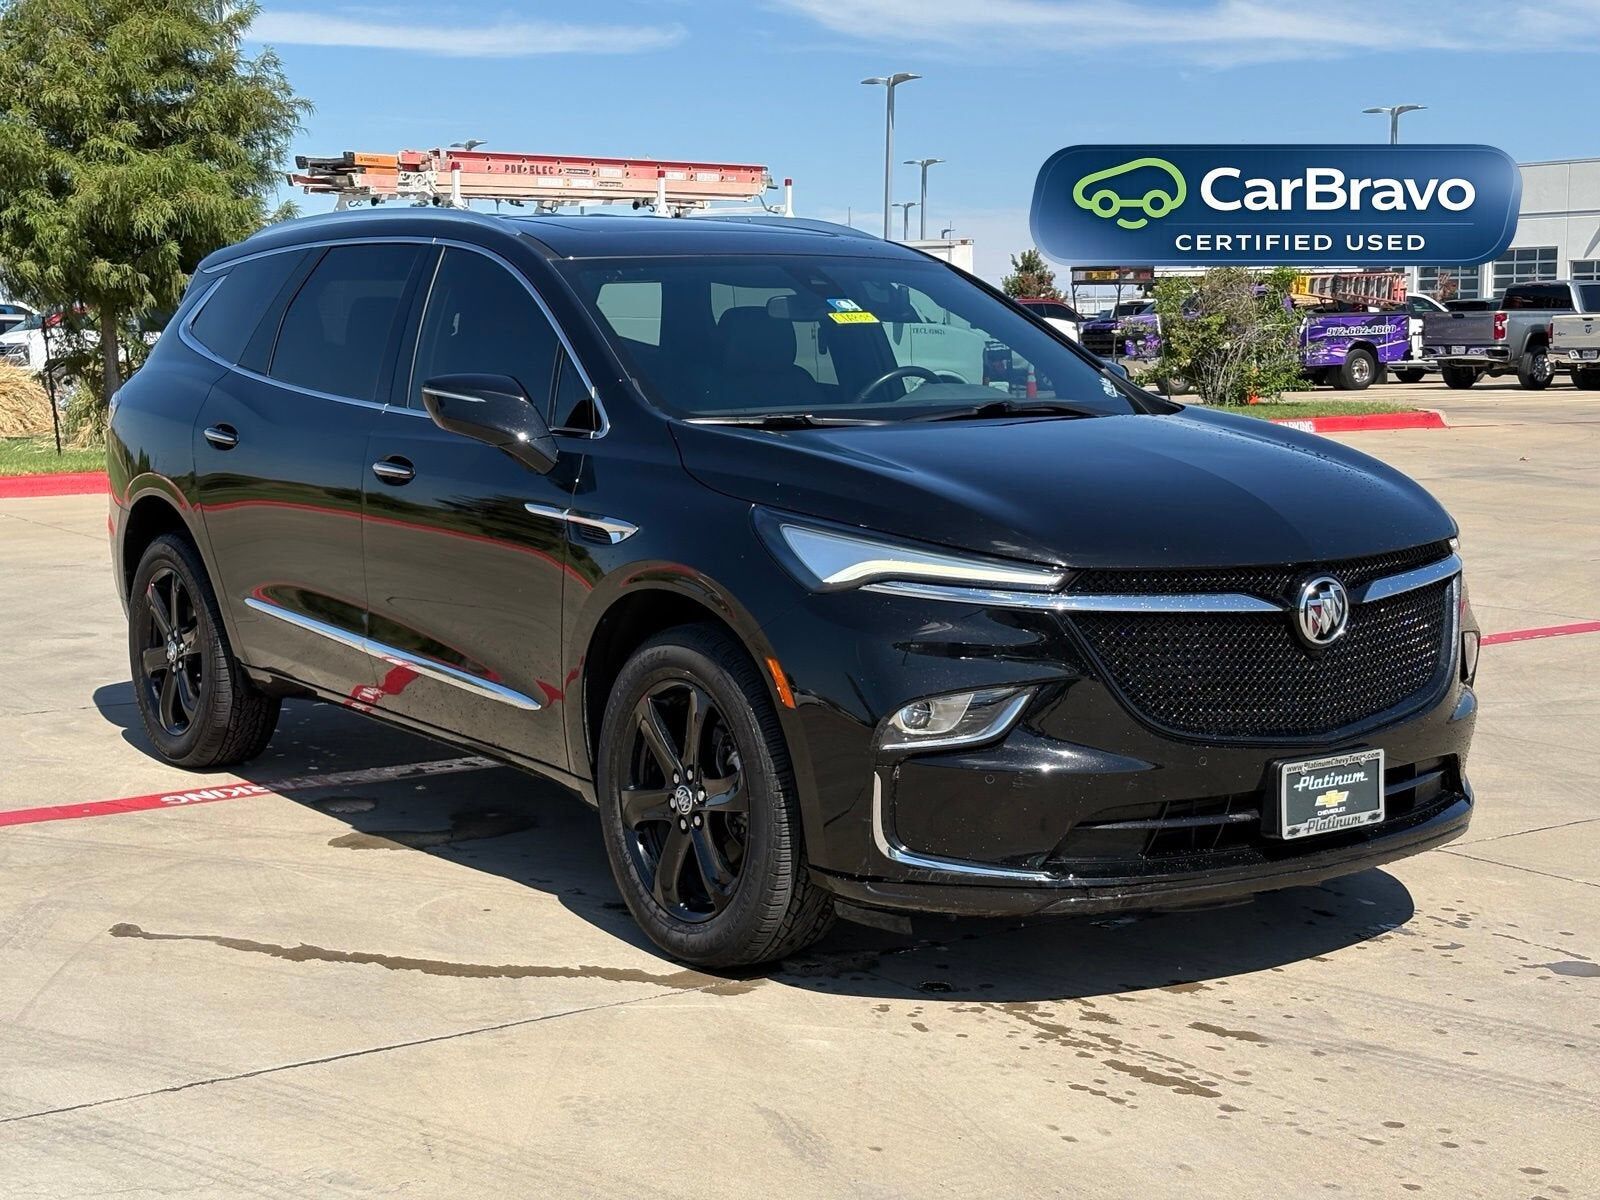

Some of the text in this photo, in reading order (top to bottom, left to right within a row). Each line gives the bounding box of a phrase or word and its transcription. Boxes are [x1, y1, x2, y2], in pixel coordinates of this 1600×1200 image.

[1278, 420, 1314, 433] RKING
[1293, 772, 1368, 792] Platinum
[1303, 814, 1365, 834] Platinum
